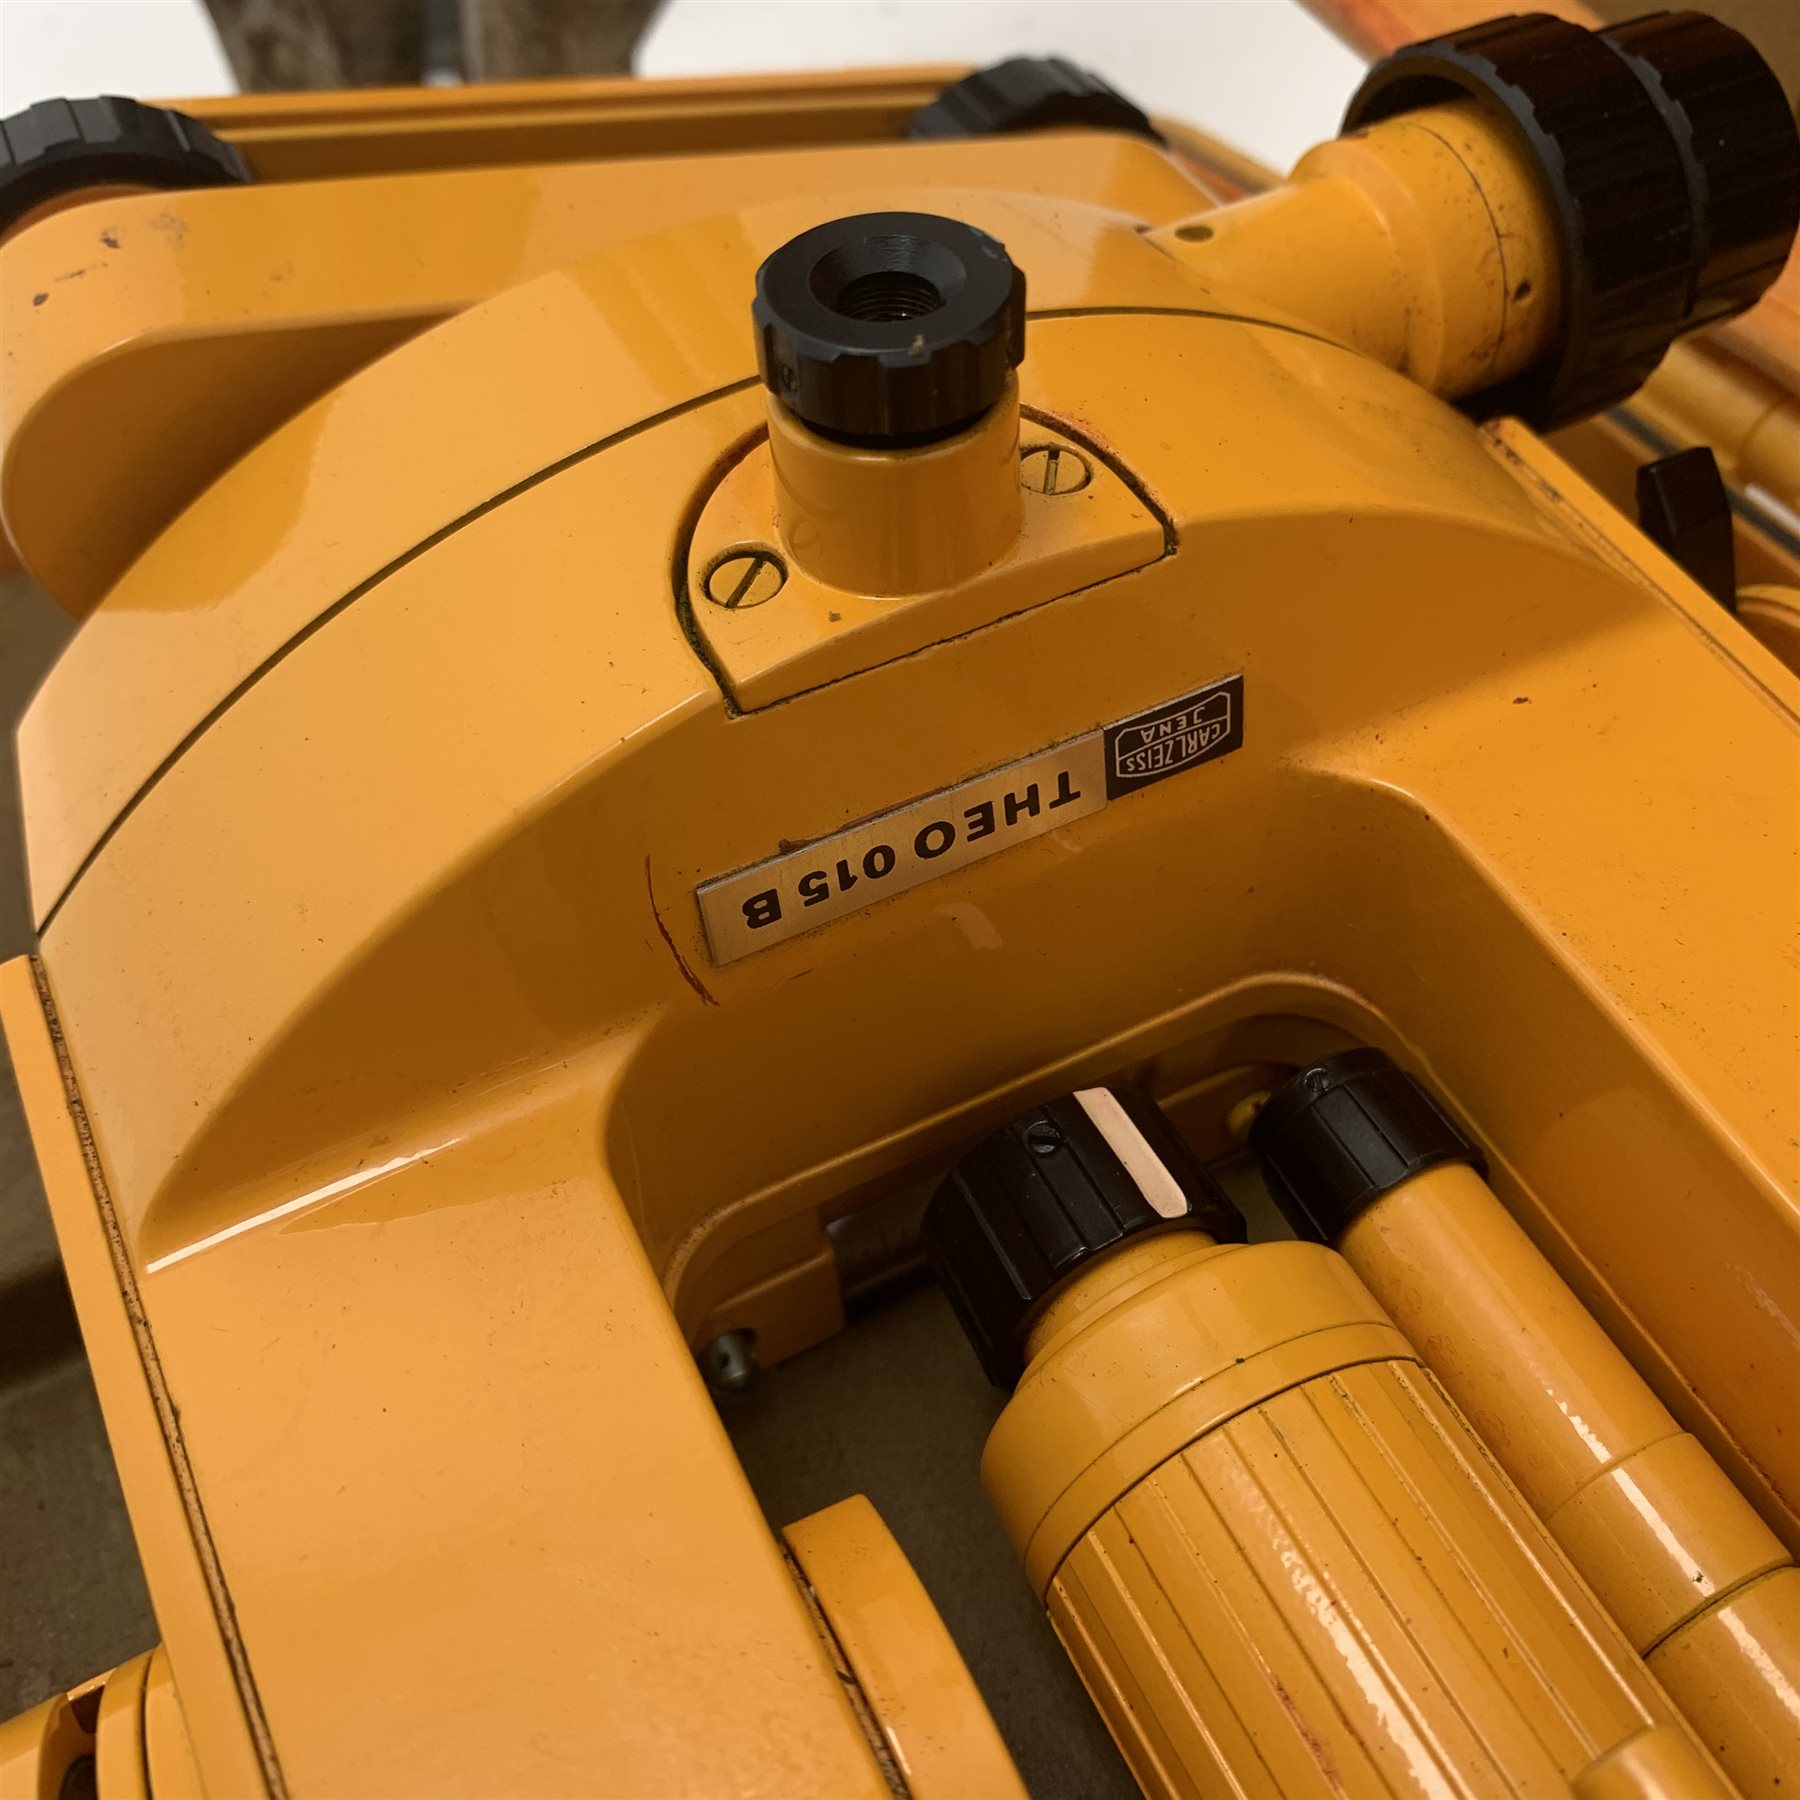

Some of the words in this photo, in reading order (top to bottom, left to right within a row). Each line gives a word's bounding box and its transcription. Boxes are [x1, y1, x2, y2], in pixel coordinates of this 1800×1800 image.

[1140, 706, 1205, 744] JENA
[1176, 723, 1220, 757] CARL
[1126, 739, 1175, 772] ZEISS
[914, 771, 1081, 859] THEO
[798, 845, 895, 907] 015
[742, 888, 782, 929] B
